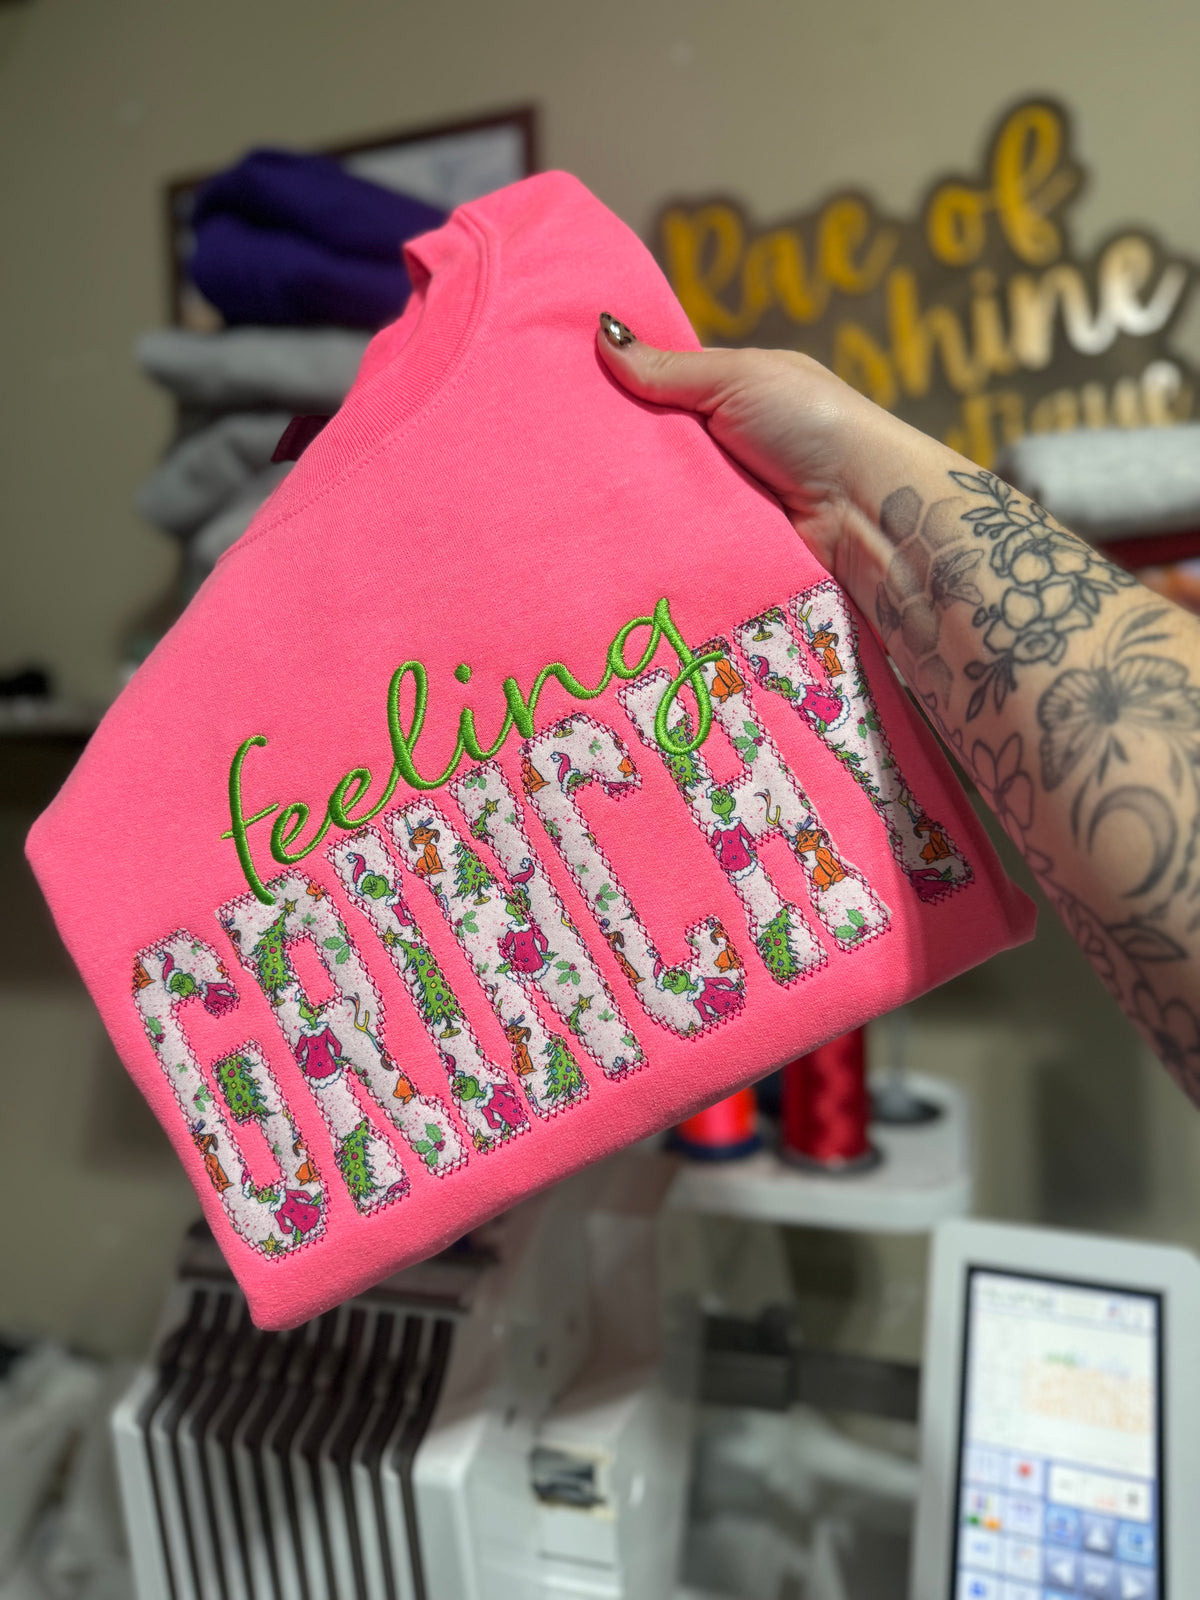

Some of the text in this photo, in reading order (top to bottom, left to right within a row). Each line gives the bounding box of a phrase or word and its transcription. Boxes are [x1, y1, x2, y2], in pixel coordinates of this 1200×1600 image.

[926, 103, 1086, 266] of
[220, 597, 723, 906] feeling
[132, 579, 976, 1260] GRINCHY
